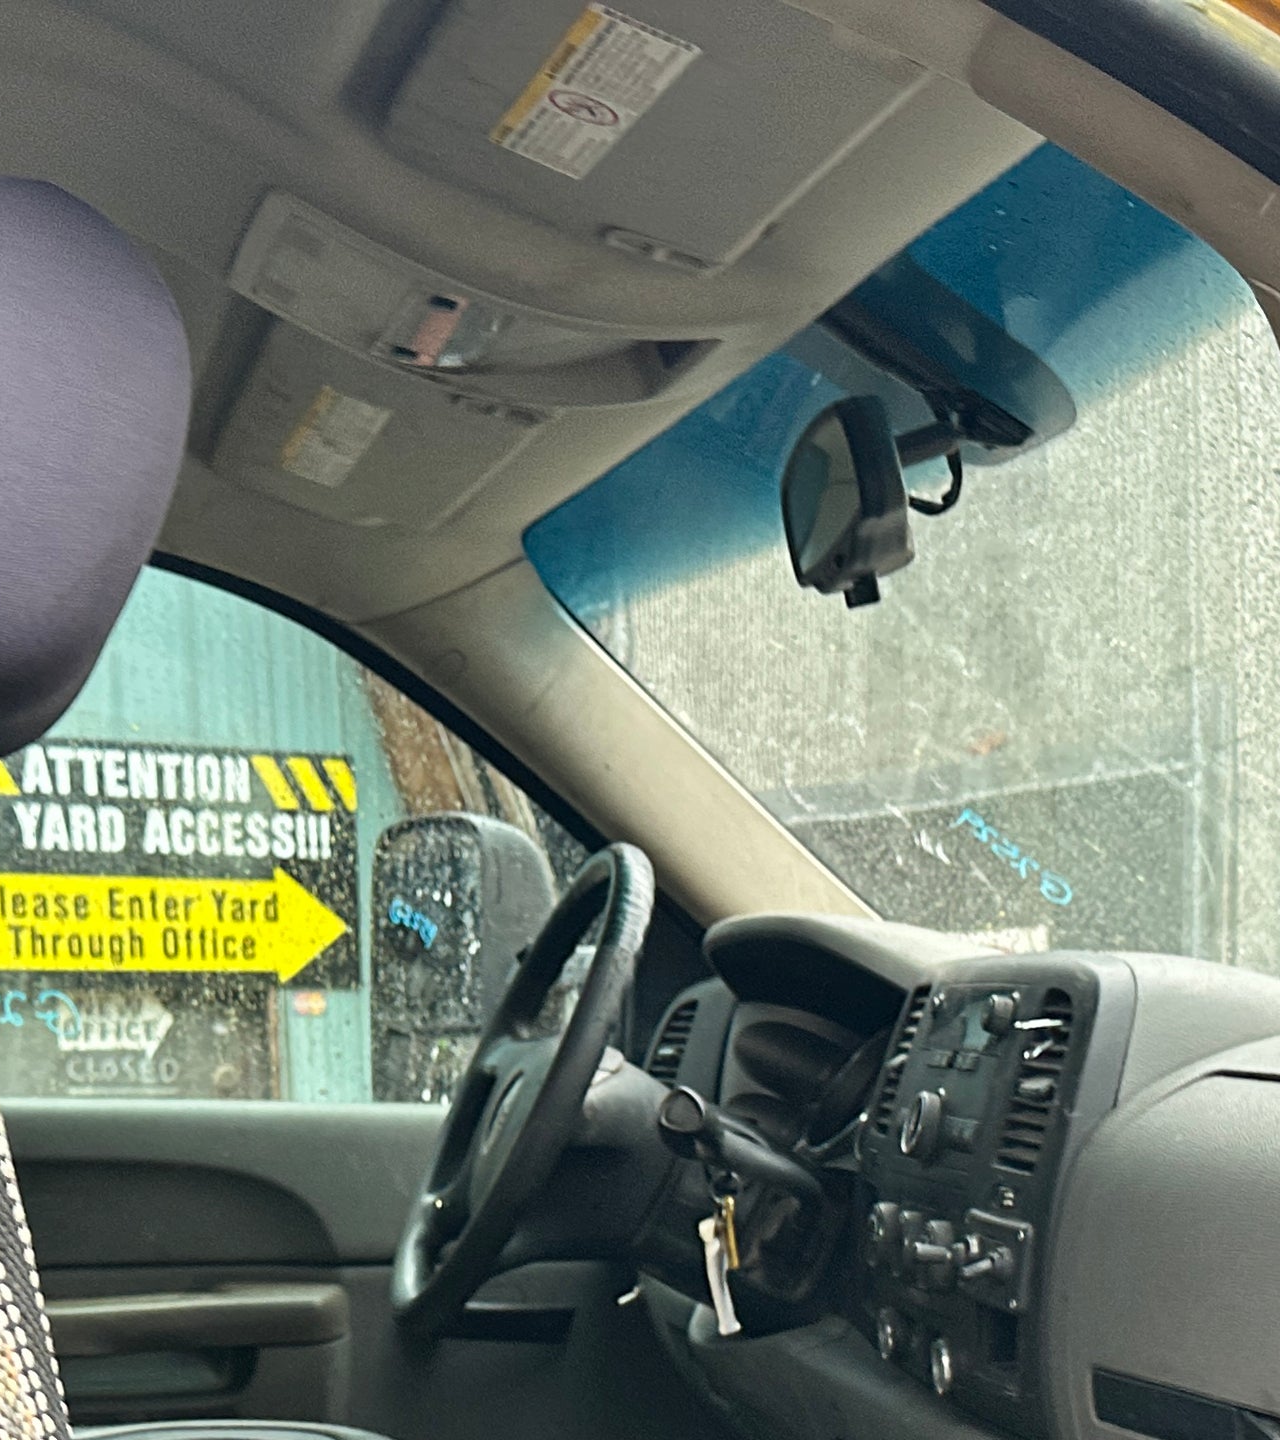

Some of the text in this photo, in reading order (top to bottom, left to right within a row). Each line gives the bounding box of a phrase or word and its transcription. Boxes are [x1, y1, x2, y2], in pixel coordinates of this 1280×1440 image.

[22, 745, 250, 802] ATTENTION
[13, 805, 127, 852] YARD
[143, 810, 332, 860] ACCESS!!!
[107, 886, 195, 924] Enter
[211, 893, 280, 924] Yard
[9, 926, 256, 966] Through Office
